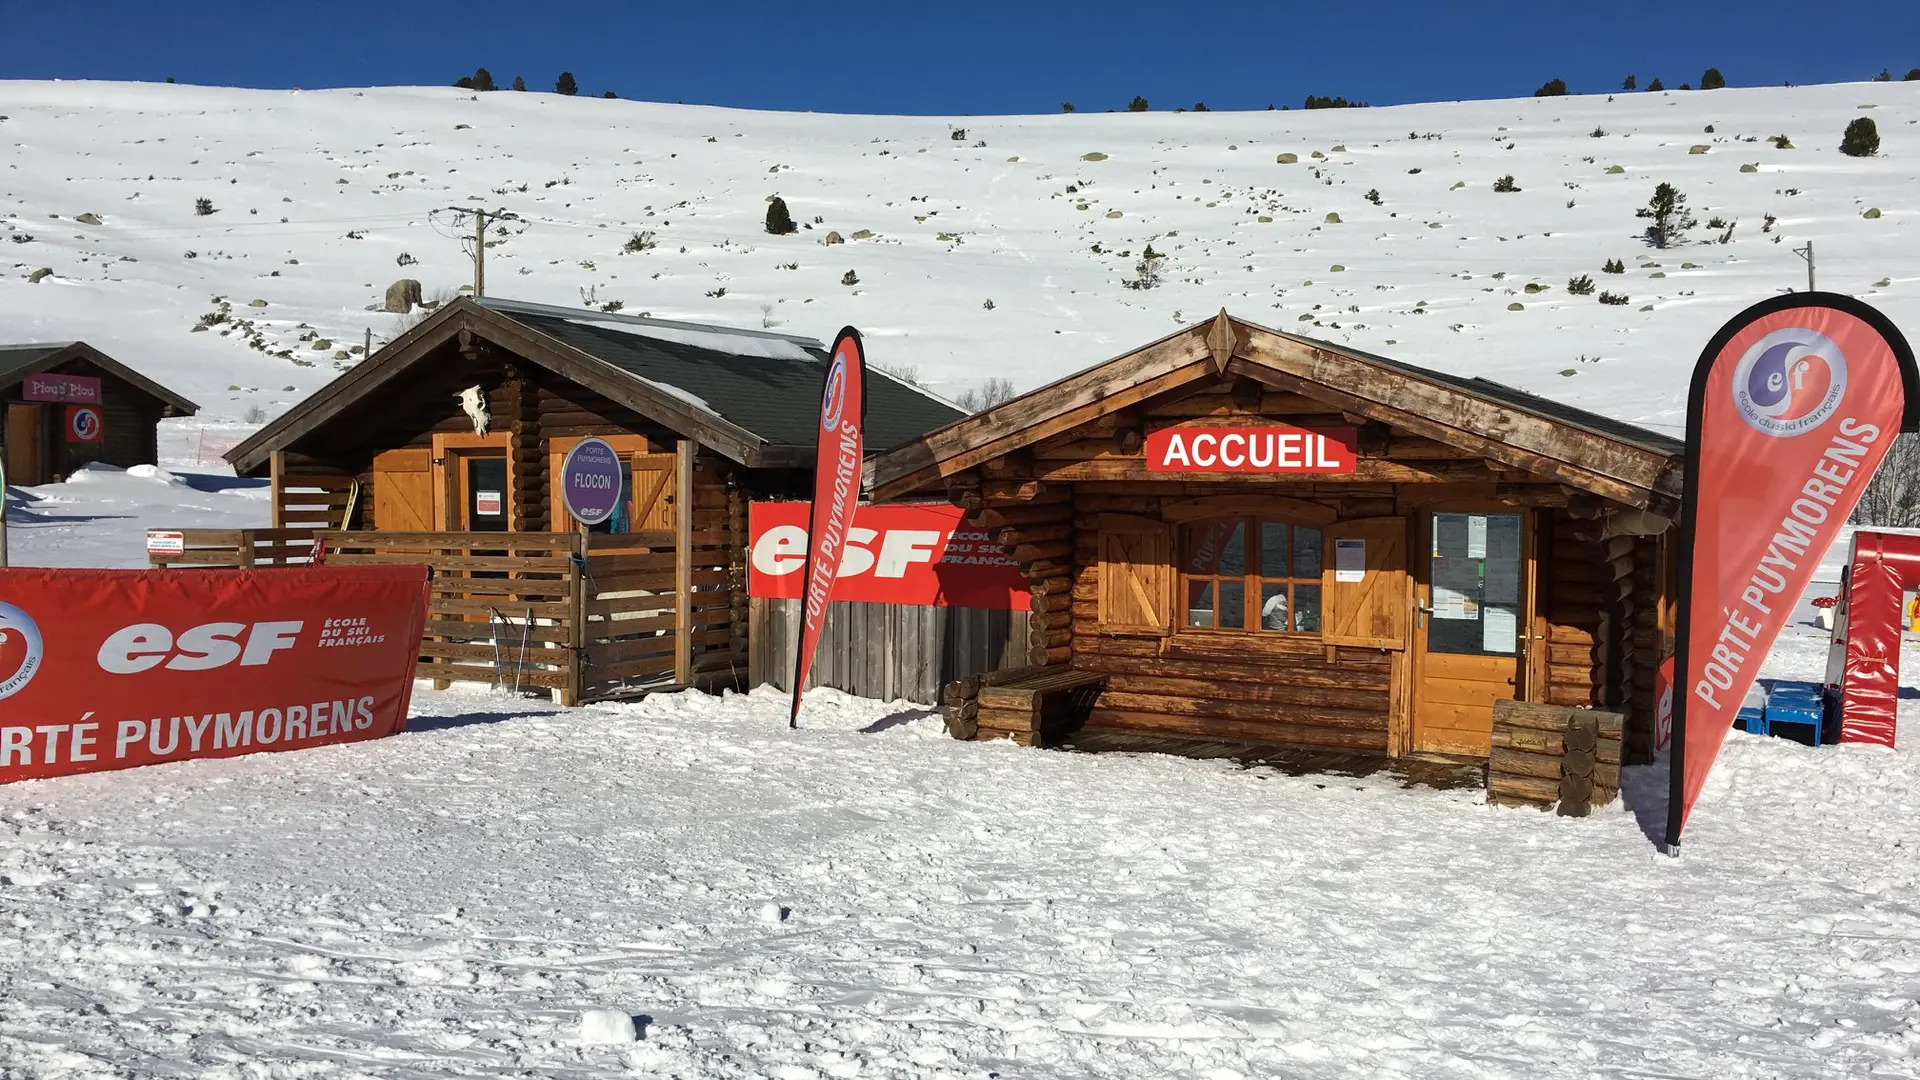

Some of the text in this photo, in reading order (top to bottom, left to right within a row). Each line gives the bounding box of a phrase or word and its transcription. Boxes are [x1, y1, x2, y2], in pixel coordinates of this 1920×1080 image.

[1739, 384, 1840, 431] école du ski français
[1162, 434, 1340, 468] ACCUEIL
[574, 473, 611, 490] FLOCON
[806, 556, 833, 631] PORTÉ
[821, 420, 858, 562] PUYMORENS
[946, 529, 990, 541] ÉCOL
[943, 544, 1005, 554] DU SK
[1695, 417, 1880, 711] PORTÉ PUYMORENS
[320, 627, 370, 638] DU SKI
[324, 617, 367, 628] ÉCOLE
[318, 635, 385, 648] FRANÇAIS
[0, 656, 36, 694] rançais
[0, 696, 374, 767] RTÉ PUYMORENS
